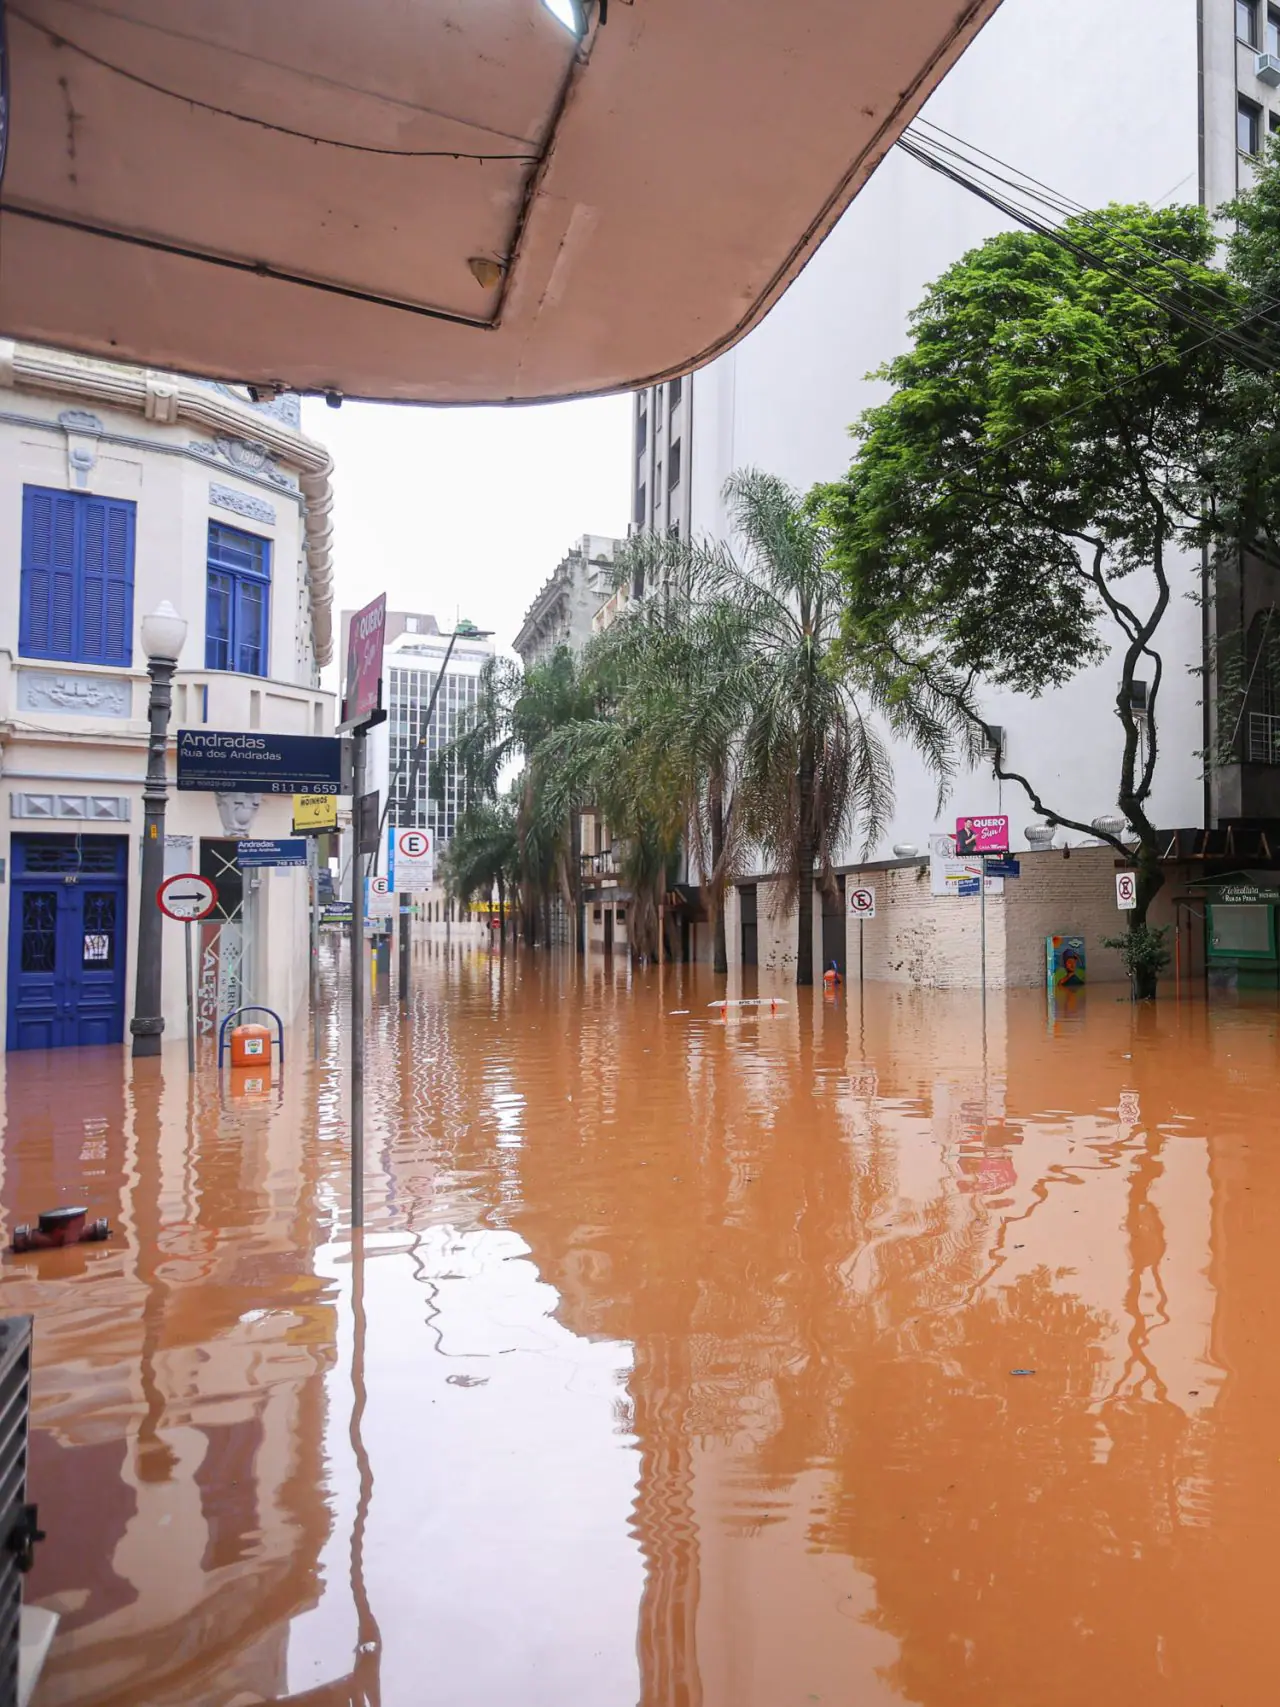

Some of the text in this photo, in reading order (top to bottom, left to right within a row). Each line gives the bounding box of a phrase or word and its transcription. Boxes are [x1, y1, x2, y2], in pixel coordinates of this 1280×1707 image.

[360, 604, 384, 640] QUERO
[181, 732, 266, 749] Andradas
[180, 749, 282, 761] Rua dos Andradas
[271, 783, 338, 794] 811 a 659
[973, 818, 1006, 827] QUERO
[408, 837, 420, 851] E
[378, 882, 385, 890] E
